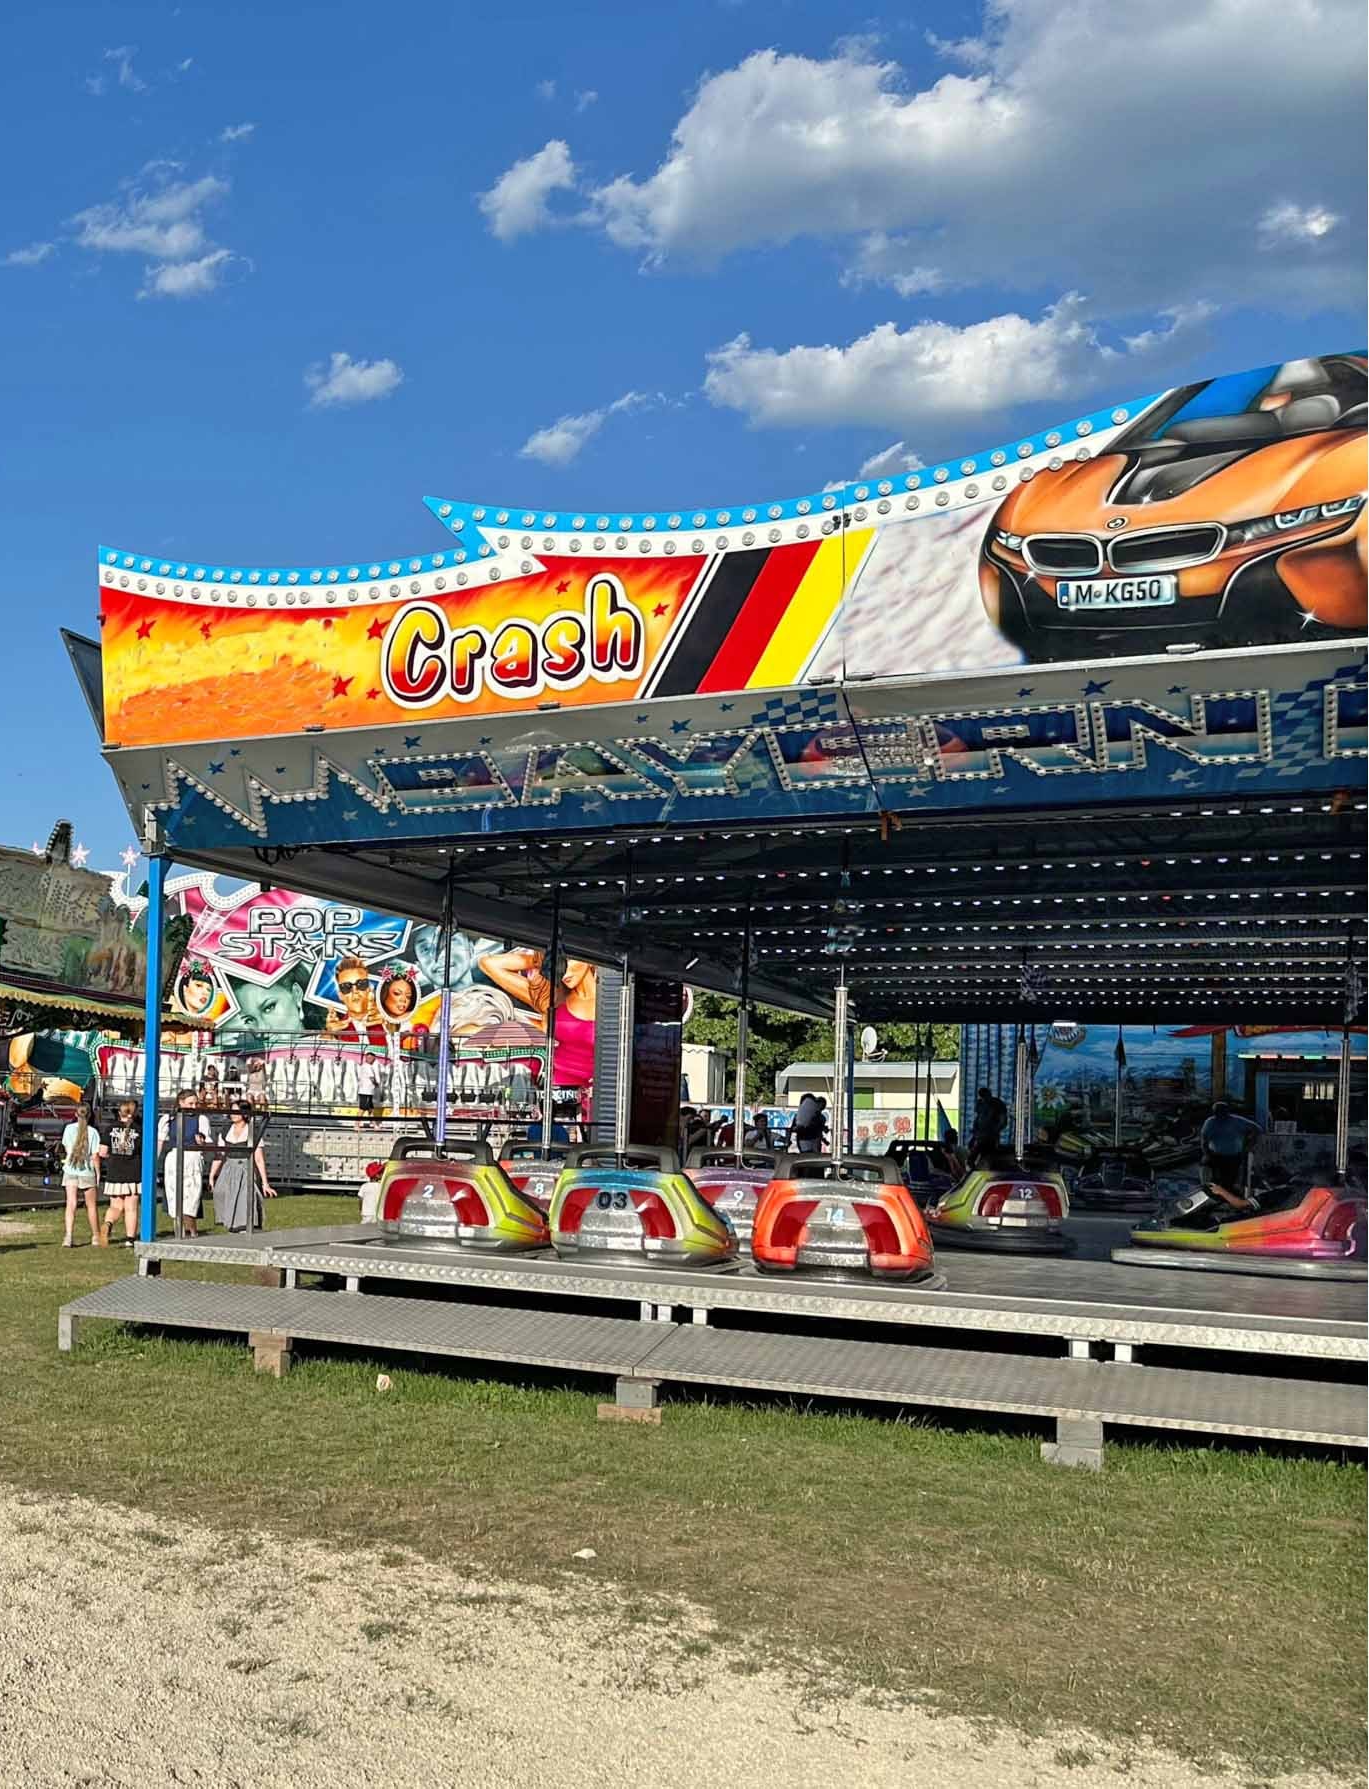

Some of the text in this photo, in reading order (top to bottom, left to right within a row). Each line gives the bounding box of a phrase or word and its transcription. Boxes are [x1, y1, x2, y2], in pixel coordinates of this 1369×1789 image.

[1105, 579, 1162, 604] KG50
[385, 578, 644, 704] Crash
[367, 687, 1273, 815] BAYERN
[248, 906, 361, 935] POP
[422, 1184, 434, 1198] 2
[596, 1191, 628, 1211] 03
[1018, 1188, 1033, 1199] 12
[824, 1207, 845, 1225] 14
